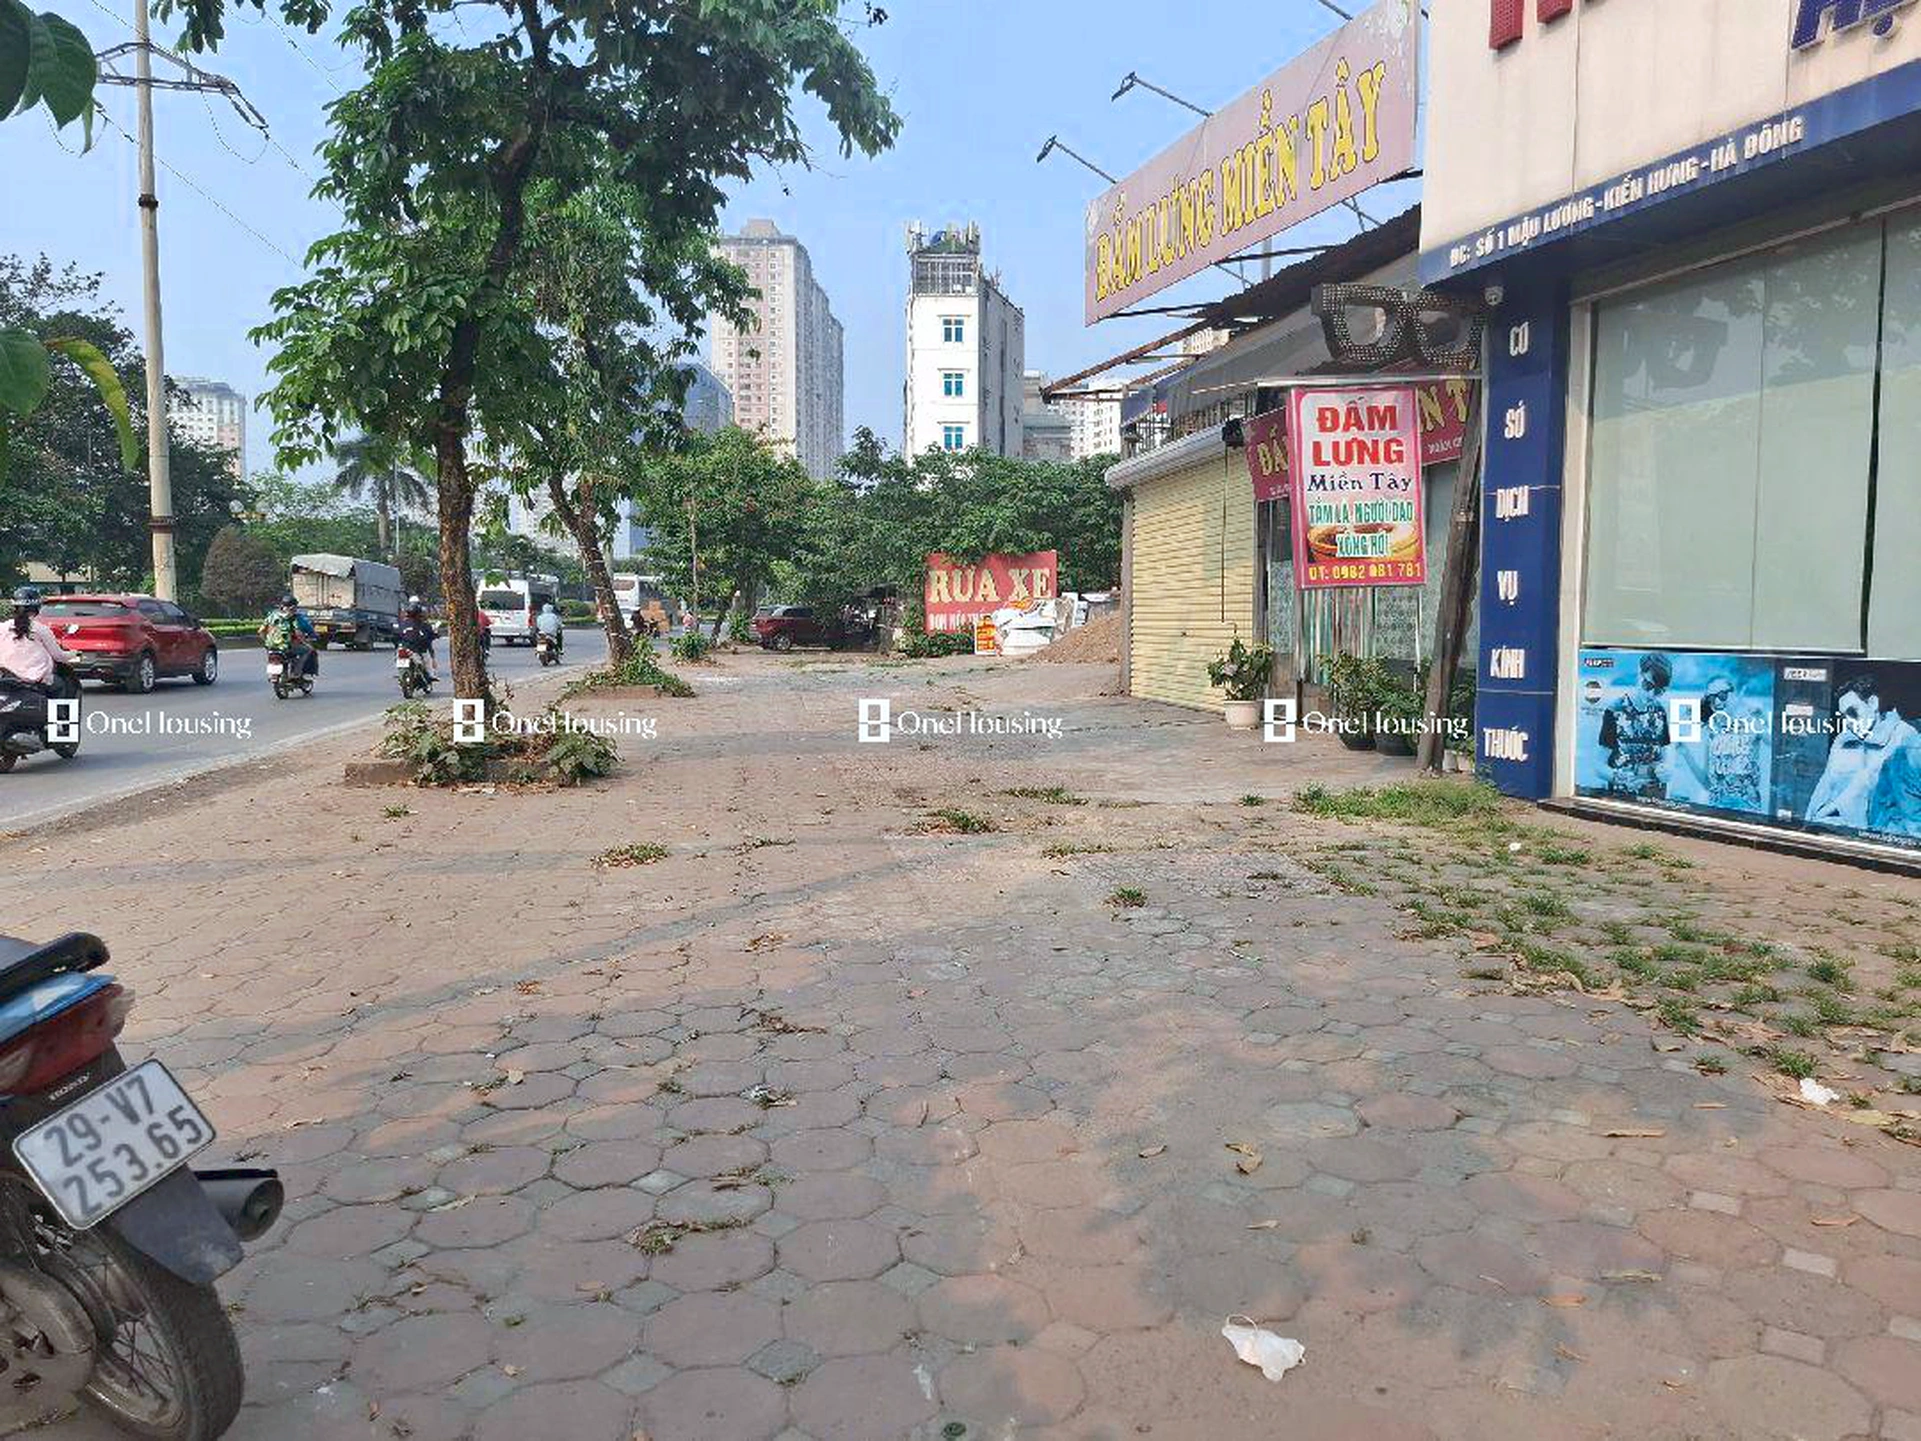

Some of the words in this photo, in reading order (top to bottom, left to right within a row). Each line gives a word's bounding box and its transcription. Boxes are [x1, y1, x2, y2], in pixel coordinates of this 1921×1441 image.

[1305, 56, 1386, 191] TÂY
[1316, 396, 1398, 433] ĐẤM
[1312, 437, 1404, 467] LƯNG
[1307, 471, 1363, 492] Miền
[1369, 472, 1412, 492] Tây
[1496, 485, 1529, 522] DỊCH
[1008, 568, 1052, 601] XE
[1497, 570, 1518, 606] VỤ
[1490, 645, 1525, 679] KÍNH
[1483, 725, 1529, 762] THUỐC
[44, 1074, 154, 1167] 29-V7
[62, 1105, 203, 1216] 253.65
